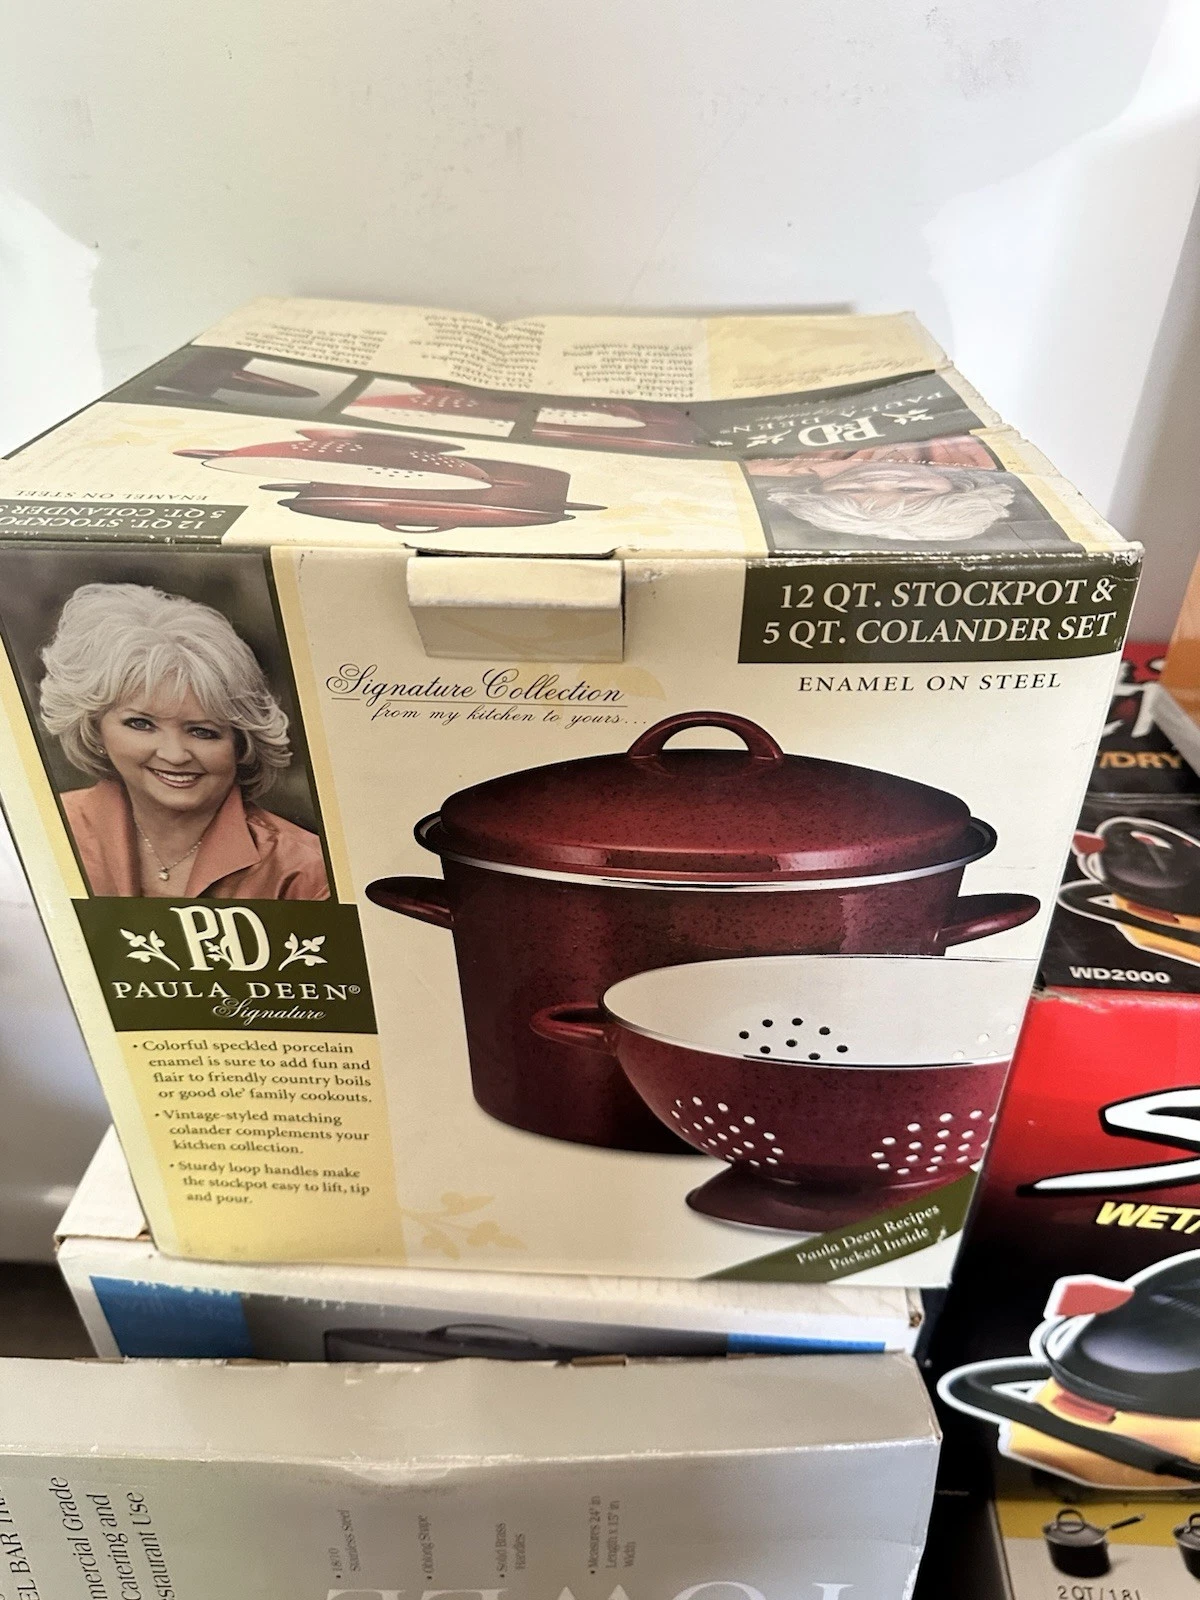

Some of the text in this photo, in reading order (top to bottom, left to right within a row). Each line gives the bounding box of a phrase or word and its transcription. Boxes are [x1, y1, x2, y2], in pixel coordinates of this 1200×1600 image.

[839, 391, 944, 418] PAULA
[14, 490, 76, 498] STEEL
[11, 505, 156, 517] COLANDER
[163, 508, 205, 518] QT.
[210, 510, 226, 518] 5
[130, 518, 173, 529] QT.
[178, 520, 206, 529] 12
[781, 577, 1117, 613] 12 QT. STOCKPOT &
[762, 611, 1117, 648] 5 QT. COLANDER SET
[326, 663, 624, 707] Signature Collection
[798, 673, 1061, 692] ENAMEL ON STEEL
[371, 702, 421, 721] from
[429, 710, 459, 725] my
[467, 704, 535, 722] kitchen
[542, 710, 560, 721] to
[1097, 751, 1182, 768] /DRY
[169, 906, 271, 972] PD
[1068, 965, 1171, 984] WD2000
[112, 981, 231, 999] PAULA
[213, 997, 326, 1026] Signature
[143, 1040, 353, 1054] Colorful speckled porcelain
[148, 1056, 370, 1070] enamel is sure to add fun and
[153, 1072, 371, 1087] flair to friendly country boils
[158, 1089, 174, 1098] or
[179, 1088, 216, 1100] good
[249, 1088, 296, 1102] family
[300, 1091, 372, 1103] cookouts.
[163, 1109, 342, 1126] Vintage-styled matching
[169, 1125, 370, 1142] colander complements your
[173, 1139, 304, 1154] kitchen collection.
[178, 1161, 360, 1178] Sturdy loop handles make
[182, 1176, 370, 1195] the stockpot easy to lift, tip
[186, 1192, 253, 1205] and pour.
[796, 1204, 941, 1265] Paula Deen Recipes
[829, 1227, 930, 1271] Packed Inside
[49, 1476, 84, 1531] Grade
[86, 1494, 117, 1527] and
[126, 1492, 151, 1526] Use
[0, 1533, 31, 1573] BAR
